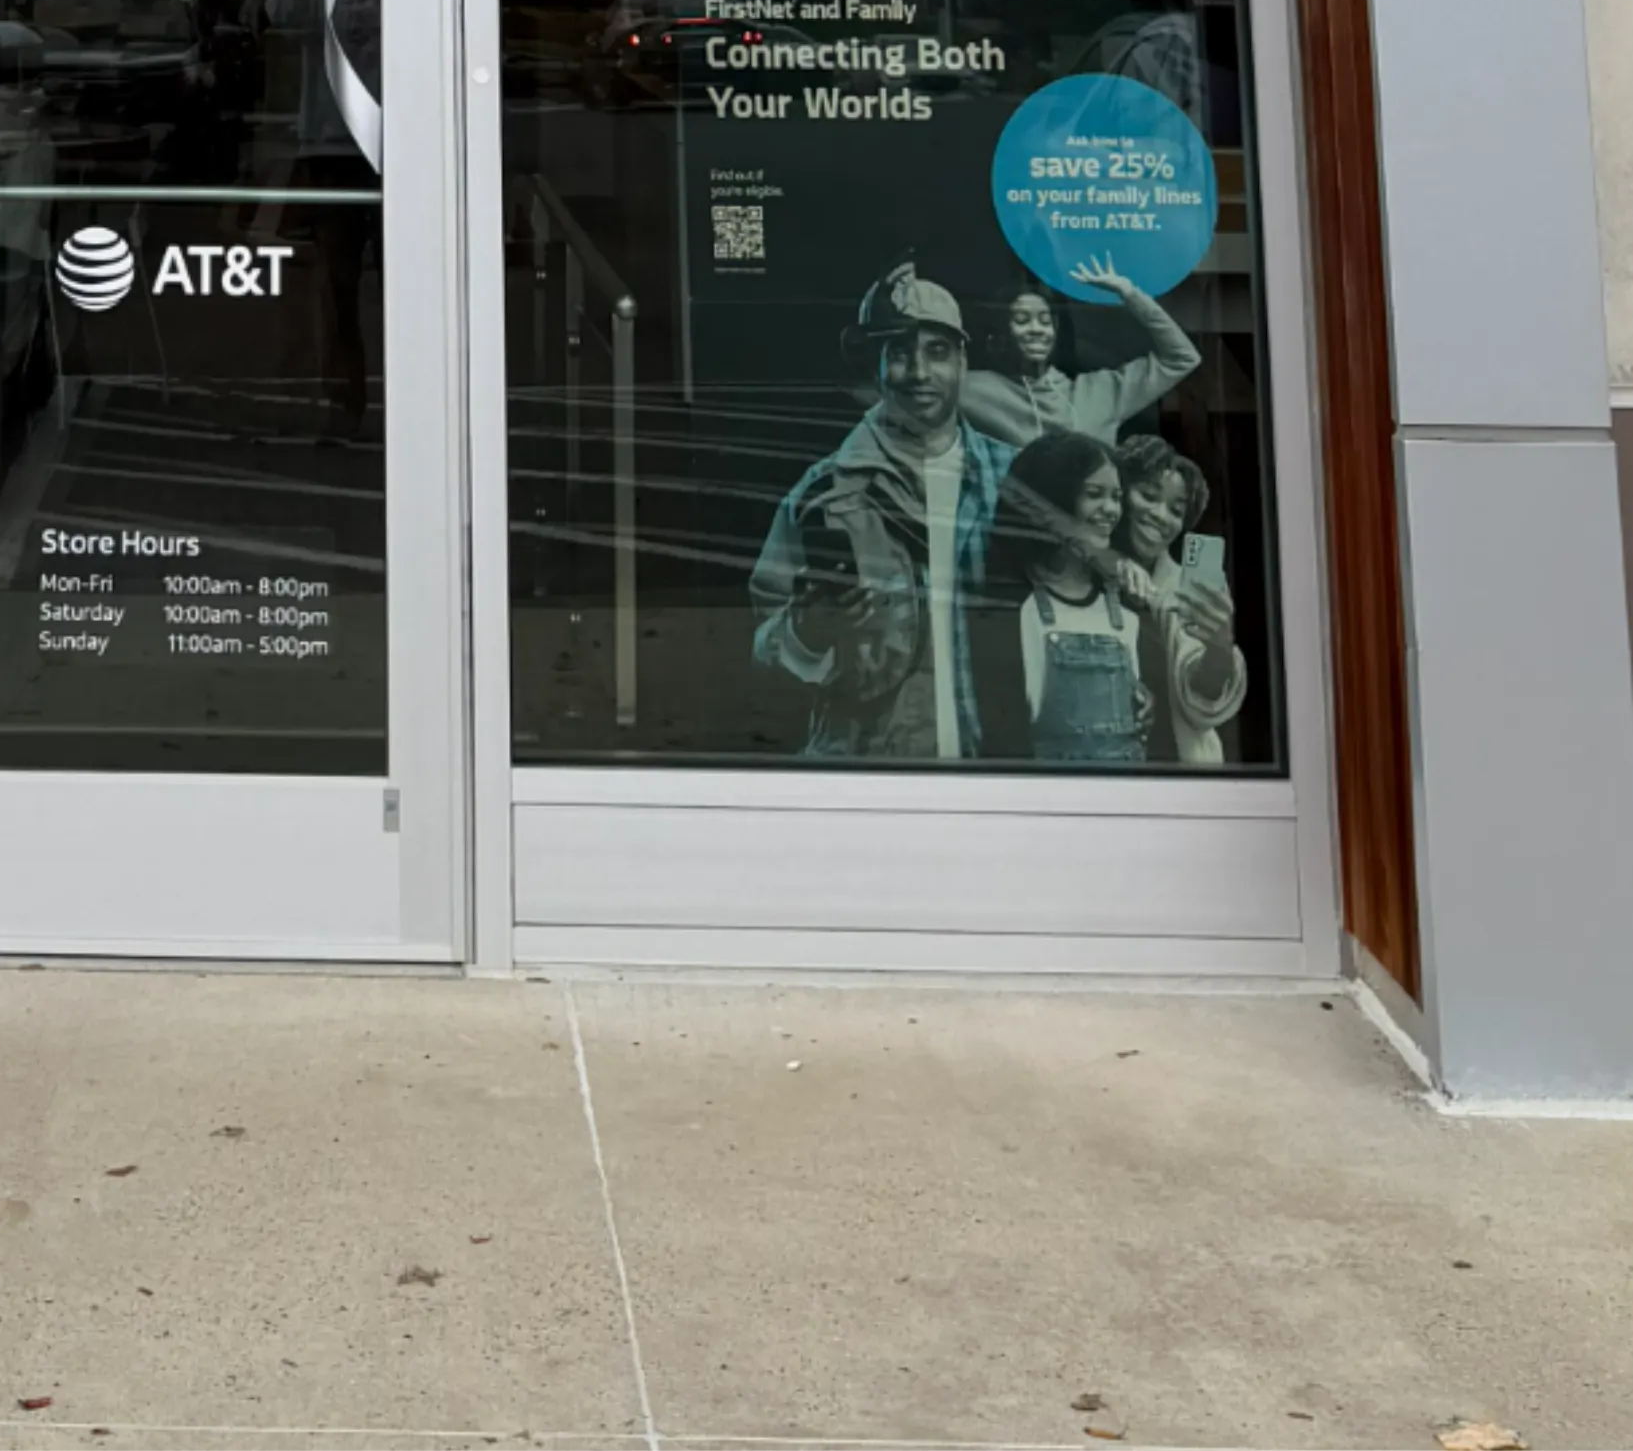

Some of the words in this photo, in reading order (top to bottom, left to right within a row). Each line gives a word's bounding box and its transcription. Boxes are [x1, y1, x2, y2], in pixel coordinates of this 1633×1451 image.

[845, 0, 917, 24] Family
[705, 36, 906, 77] Connecting
[918, 38, 1006, 71] Both
[706, 86, 793, 120] Your
[802, 86, 933, 120] Worlds
[1029, 156, 1101, 179] save
[1107, 153, 1176, 179] 25%
[1006, 189, 1032, 203] on
[1036, 189, 1083, 208] your
[1086, 186, 1151, 209] family
[1154, 187, 1203, 205] lines
[1050, 211, 1101, 229] from
[1103, 213, 1163, 230] AT&T.
[151, 245, 295, 297] AT&T
[40, 529, 116, 555] Store
[121, 530, 201, 557] Hours
[39, 573, 114, 593] Mon-Fri
[163, 576, 242, 595] 10:00am
[257, 577, 329, 601] 8:00pm
[39, 602, 126, 626] Saturday
[163, 605, 242, 625] 10:00am
[257, 606, 329, 630] 8:00pm
[38, 631, 110, 657] Sunday
[168, 634, 243, 654] 11:00am
[258, 636, 329, 660] 5:00pm
